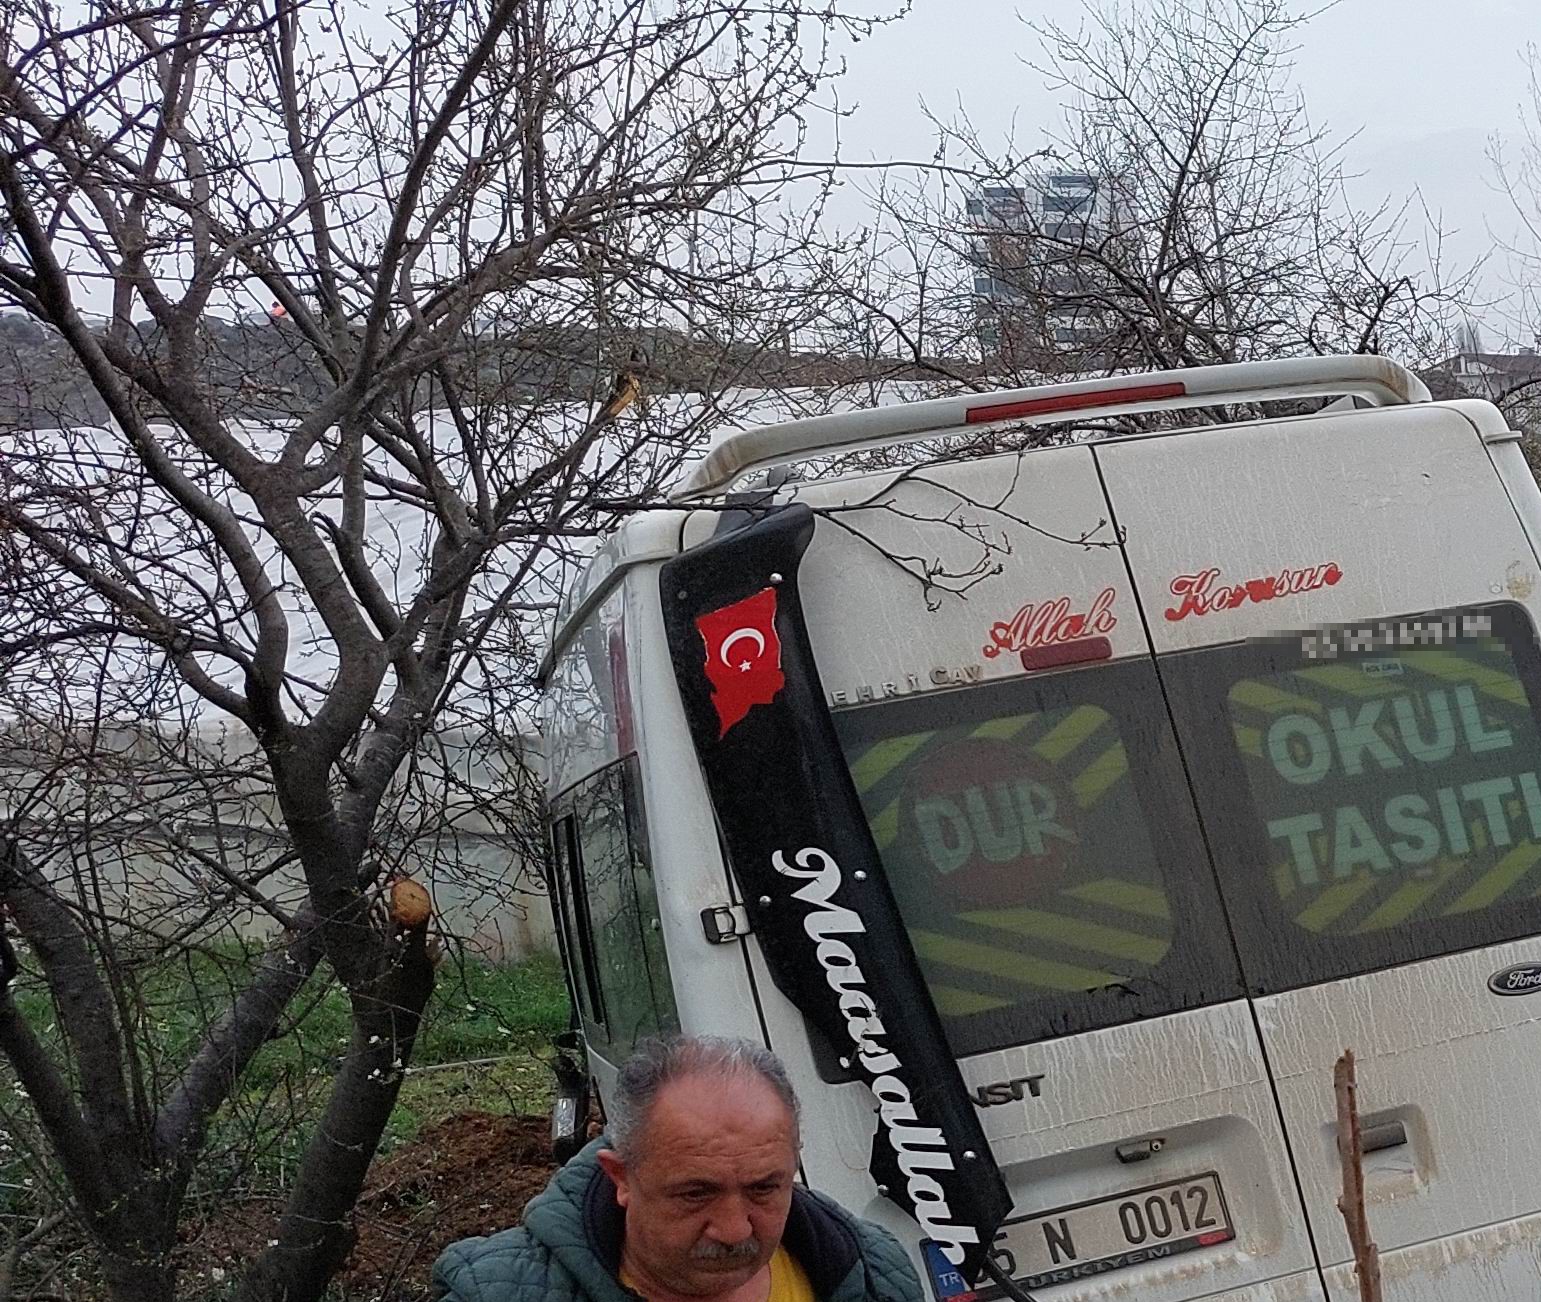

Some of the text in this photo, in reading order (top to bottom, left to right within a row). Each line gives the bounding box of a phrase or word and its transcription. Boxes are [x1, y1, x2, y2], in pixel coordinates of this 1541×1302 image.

[982, 588, 1118, 660] Allah
[1267, 685, 1514, 785] OKUL
[914, 777, 1082, 876] DUR
[1041, 1218, 1078, 1265] N
[1118, 1185, 1217, 1245] 0012
[938, 1271, 961, 1287] TR
